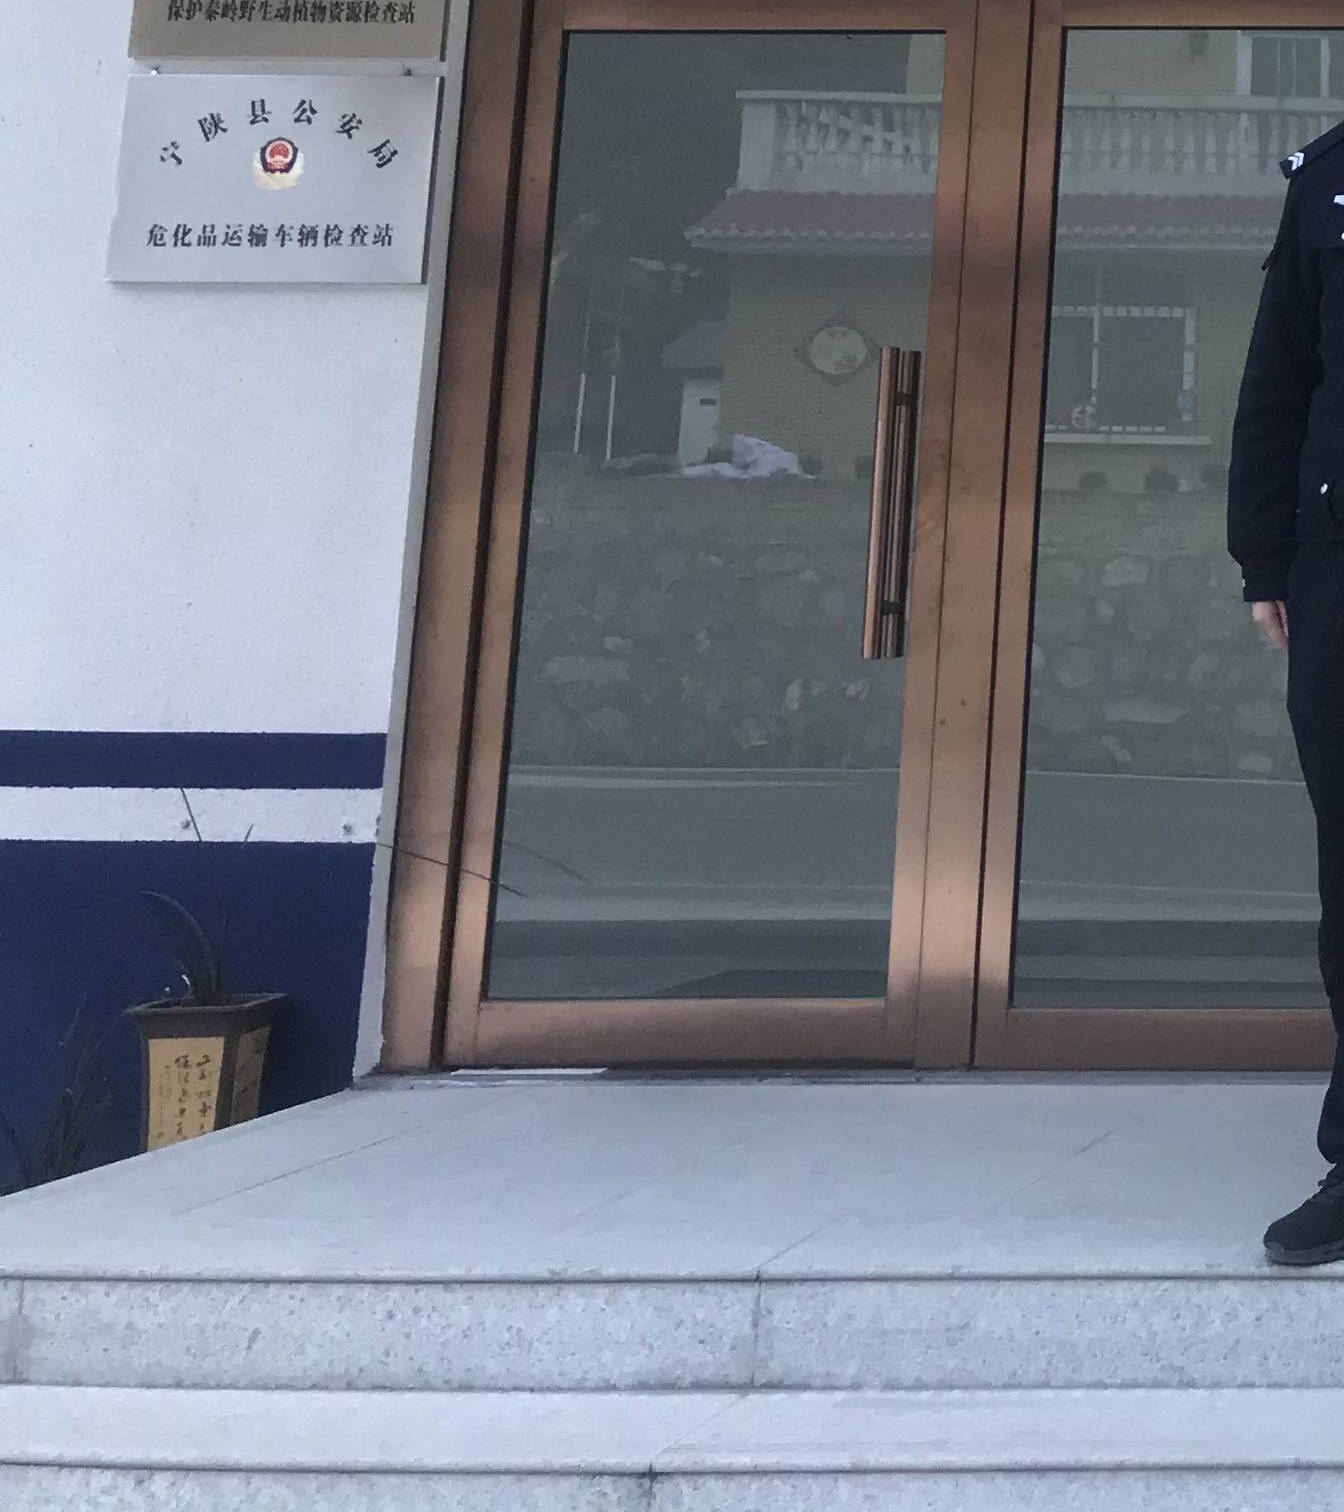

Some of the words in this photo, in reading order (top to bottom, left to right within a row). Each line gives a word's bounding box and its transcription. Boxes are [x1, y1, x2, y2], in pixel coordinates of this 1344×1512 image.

[159, 98, 399, 169] 宁陕县公安局
[146, 223, 394, 248] 危化品运输车辆检查站
